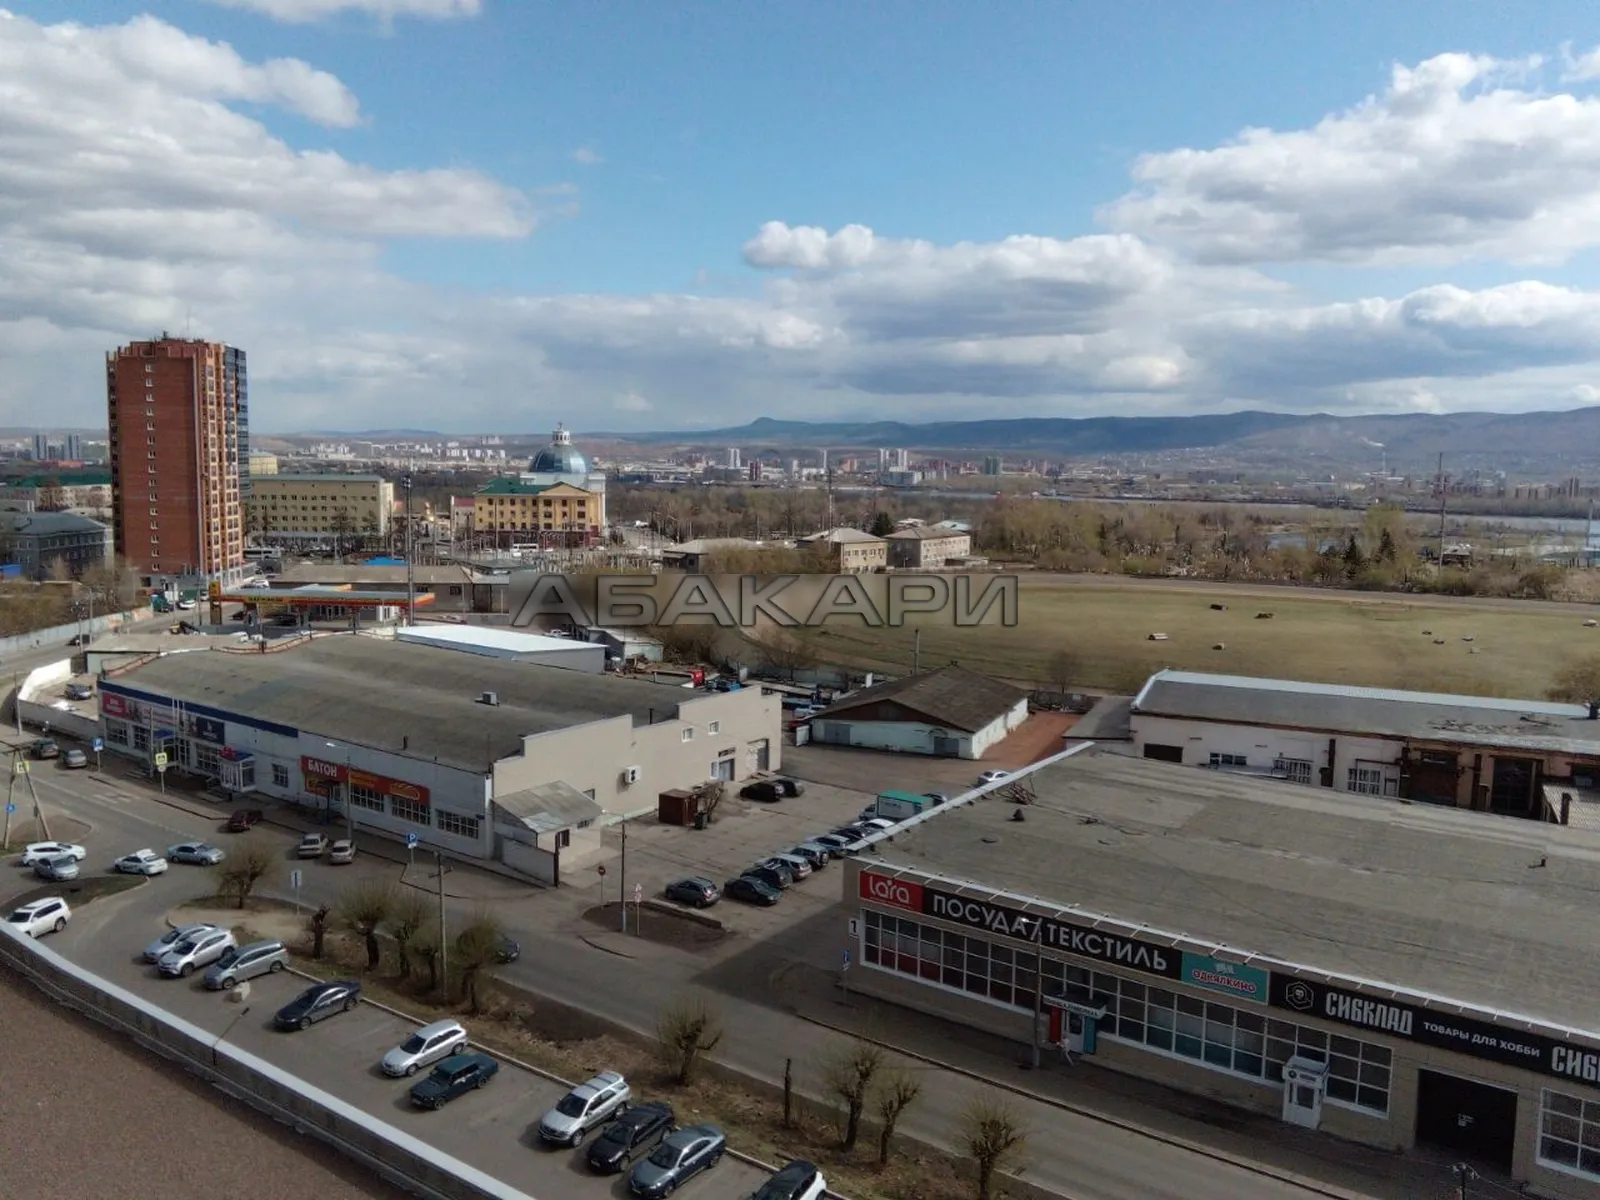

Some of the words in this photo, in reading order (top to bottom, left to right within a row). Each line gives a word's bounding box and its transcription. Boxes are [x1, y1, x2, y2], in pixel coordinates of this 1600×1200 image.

[307, 758, 338, 778] БАТОН
[1325, 992, 1413, 1035] СИБКЛАД
[1423, 1021, 1470, 1040] ТОВАРЫ
[1471, 1033, 1497, 1047] ДЛЯ
[1499, 1038, 1541, 1058] ХОББИ
[1551, 1046, 1600, 1083] СИБ
